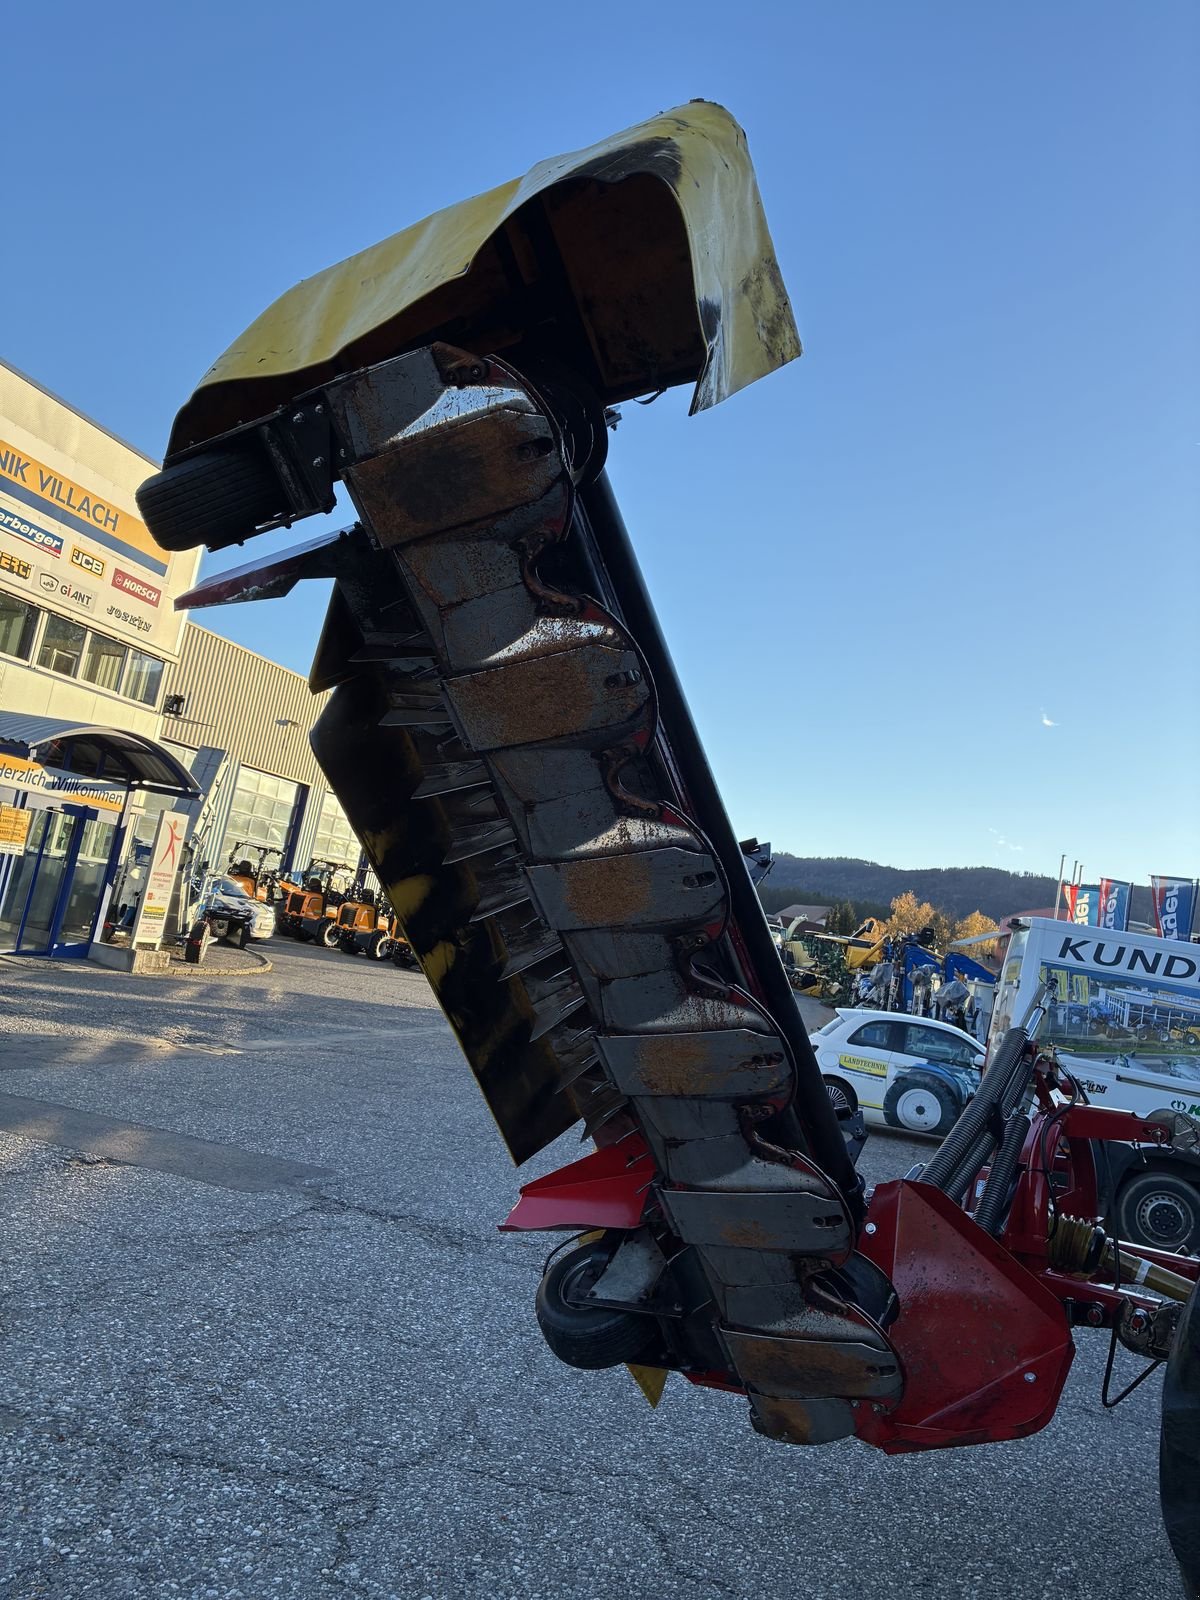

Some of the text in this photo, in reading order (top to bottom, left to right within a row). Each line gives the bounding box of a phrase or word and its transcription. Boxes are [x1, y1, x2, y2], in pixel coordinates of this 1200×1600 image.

[39, 469, 119, 532] VILLACH
[72, 550, 104, 576] JCB
[122, 578, 158, 602] HORSCH
[51, 774, 123, 805] Willkommen
[1058, 937, 1200, 982] KUND
[843, 1056, 887, 1071] LANDTECHNIK
